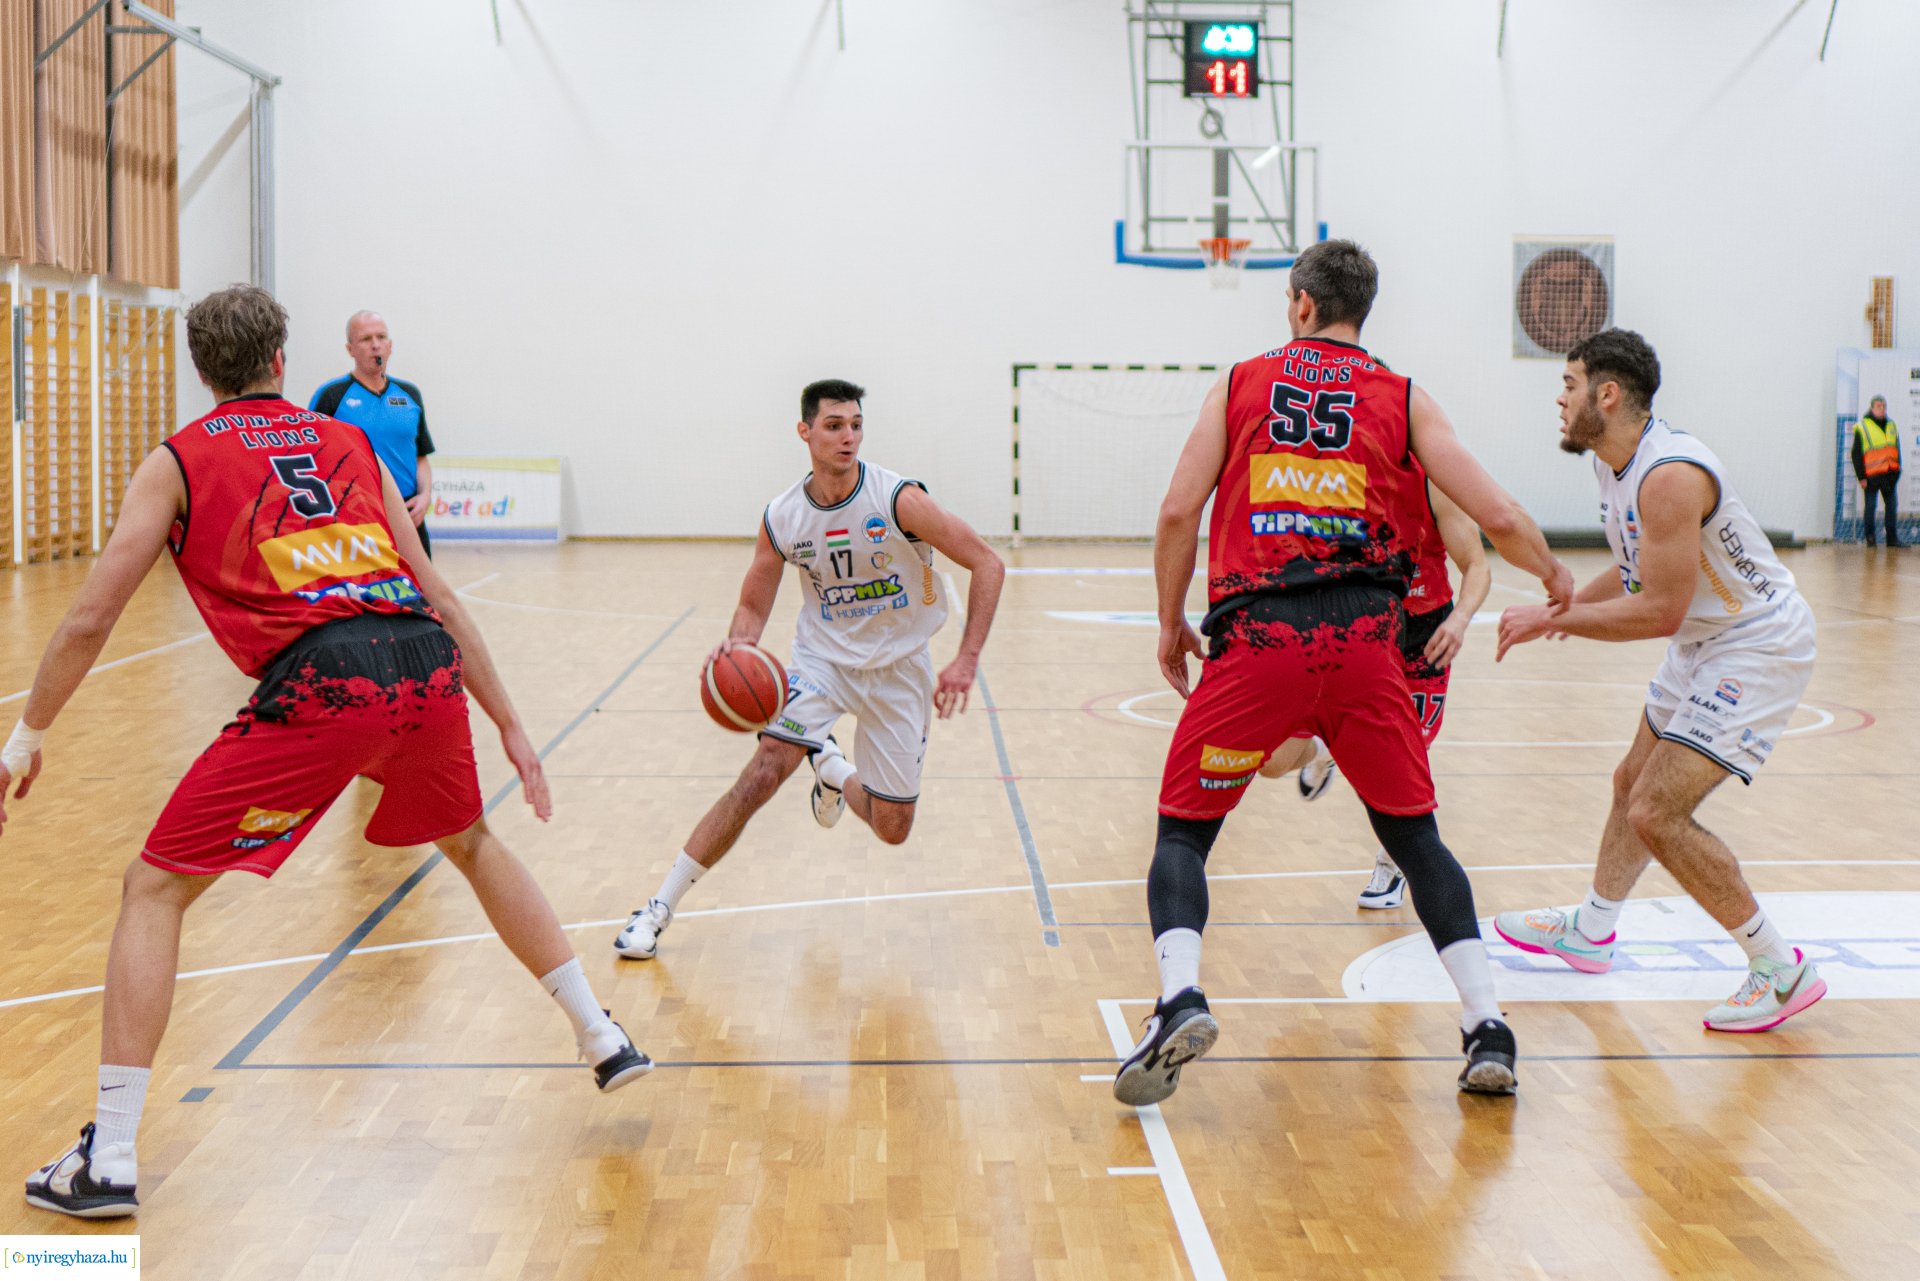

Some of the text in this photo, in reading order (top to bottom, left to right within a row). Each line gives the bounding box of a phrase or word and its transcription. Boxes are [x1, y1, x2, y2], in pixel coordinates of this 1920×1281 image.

[1206, 60, 1248, 96] 11
[1284, 359, 1351, 383] LIONS
[1269, 382, 1355, 451] 55
[239, 427, 320, 449] LIONS
[269, 453, 336, 519] 5
[1266, 466, 1348, 494] MVM
[291, 534, 382, 570] MVM
[793, 541, 813, 550] JAKO
[830, 550, 853, 579] 17
[1412, 692, 1446, 728] 17
[1688, 727, 1713, 743] JAKO
